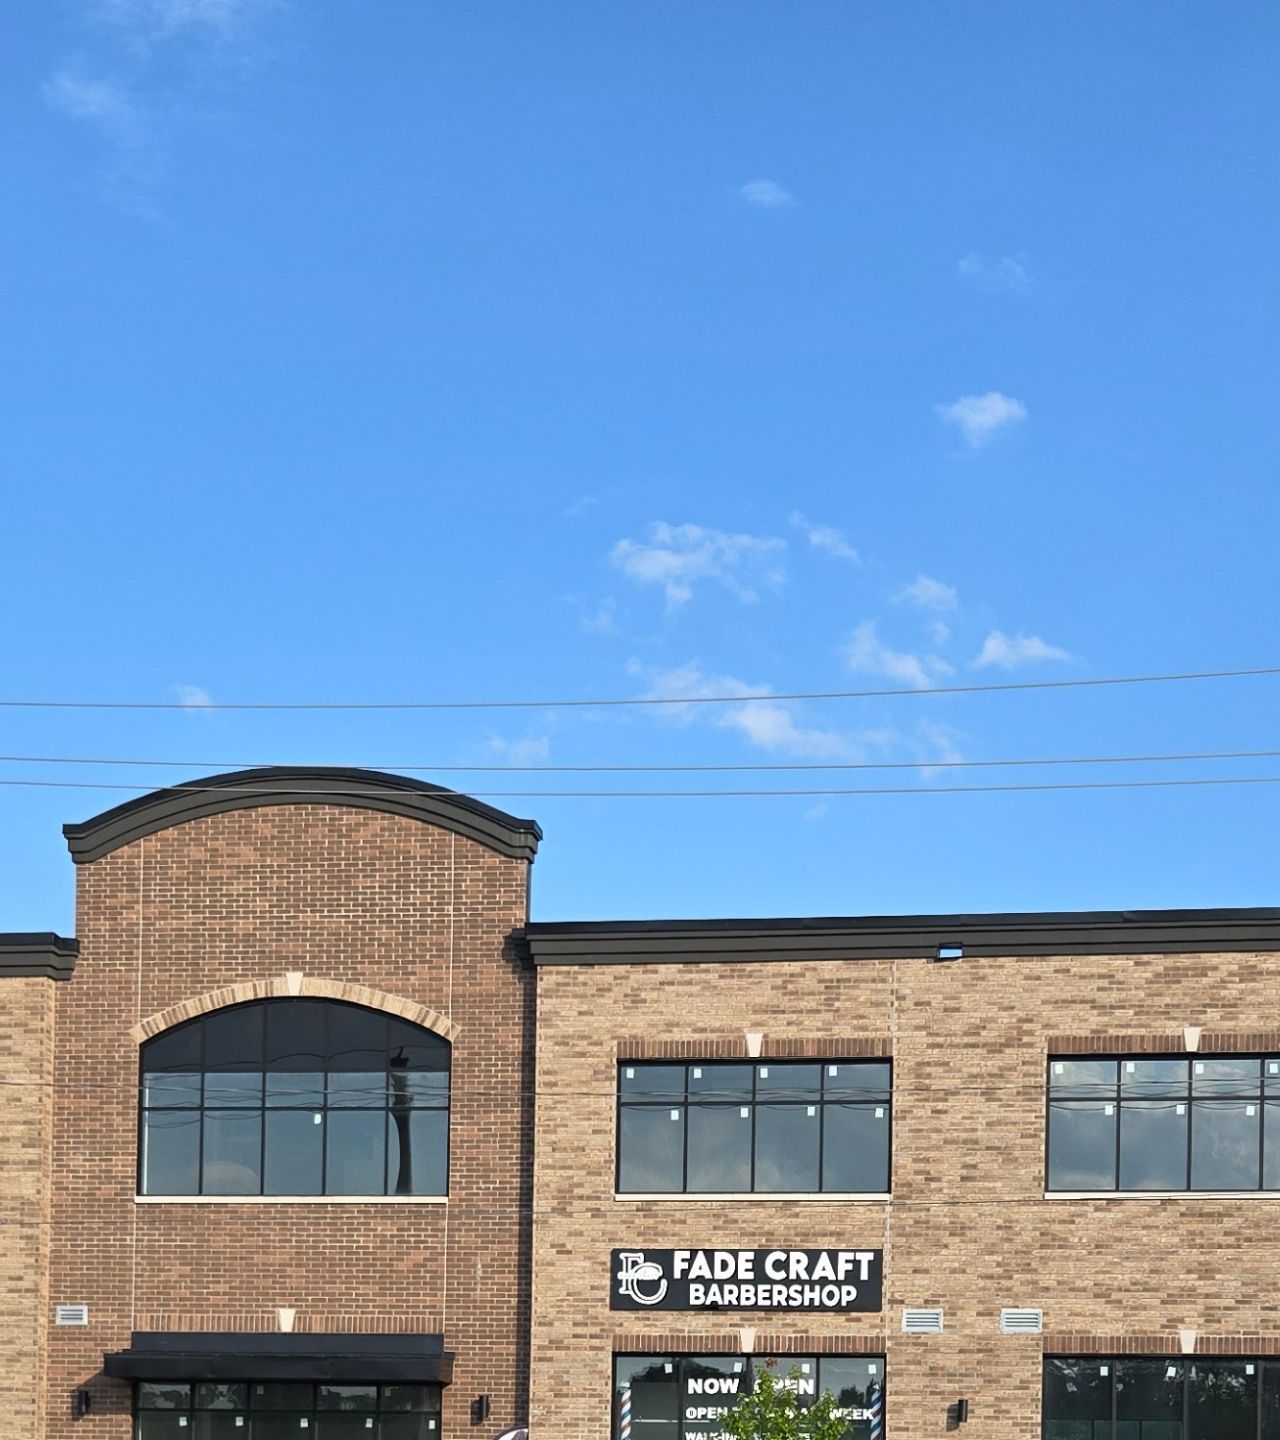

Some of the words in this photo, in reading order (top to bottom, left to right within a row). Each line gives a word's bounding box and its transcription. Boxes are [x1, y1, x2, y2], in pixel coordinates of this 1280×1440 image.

[673, 1250, 755, 1280] FADE
[764, 1250, 874, 1281] CRAFT
[689, 1283, 858, 1306] BARBERSHOP
[687, 1378, 739, 1395] NOW
